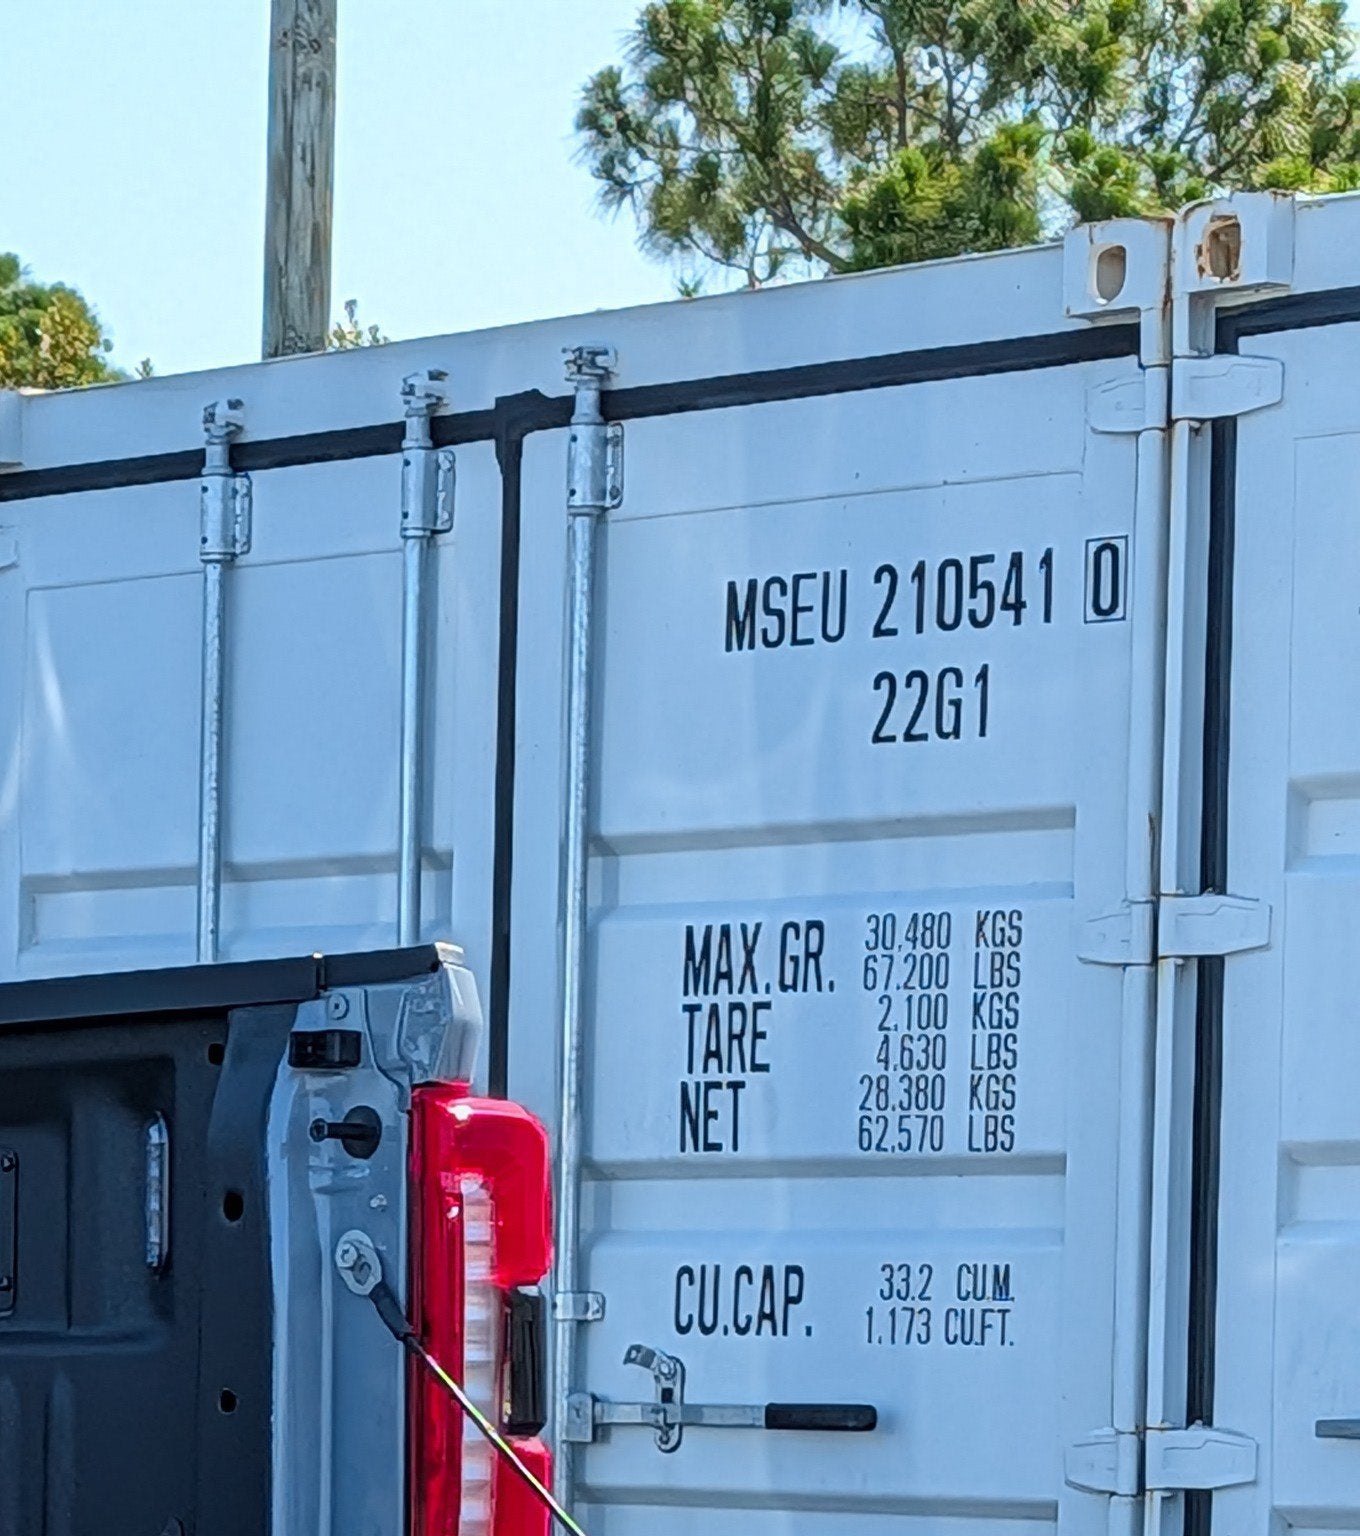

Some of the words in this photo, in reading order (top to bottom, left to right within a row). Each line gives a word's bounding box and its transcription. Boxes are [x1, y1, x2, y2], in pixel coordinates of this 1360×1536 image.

[725, 569, 847, 652] MSEU
[872, 547, 1054, 639] 210541
[871, 663, 989, 744] 22G1
[976, 910, 1023, 949] KGS
[974, 951, 1021, 990] LBS
[682, 1001, 772, 1075] TARE
[972, 992, 1019, 1031] KGS
[971, 1033, 1018, 1072] LBS
[680, 1081, 746, 1153] NET
[969, 1073, 1016, 1112] KGS
[968, 1114, 1015, 1153] LBS
[879, 1264, 933, 1302] 33.2
